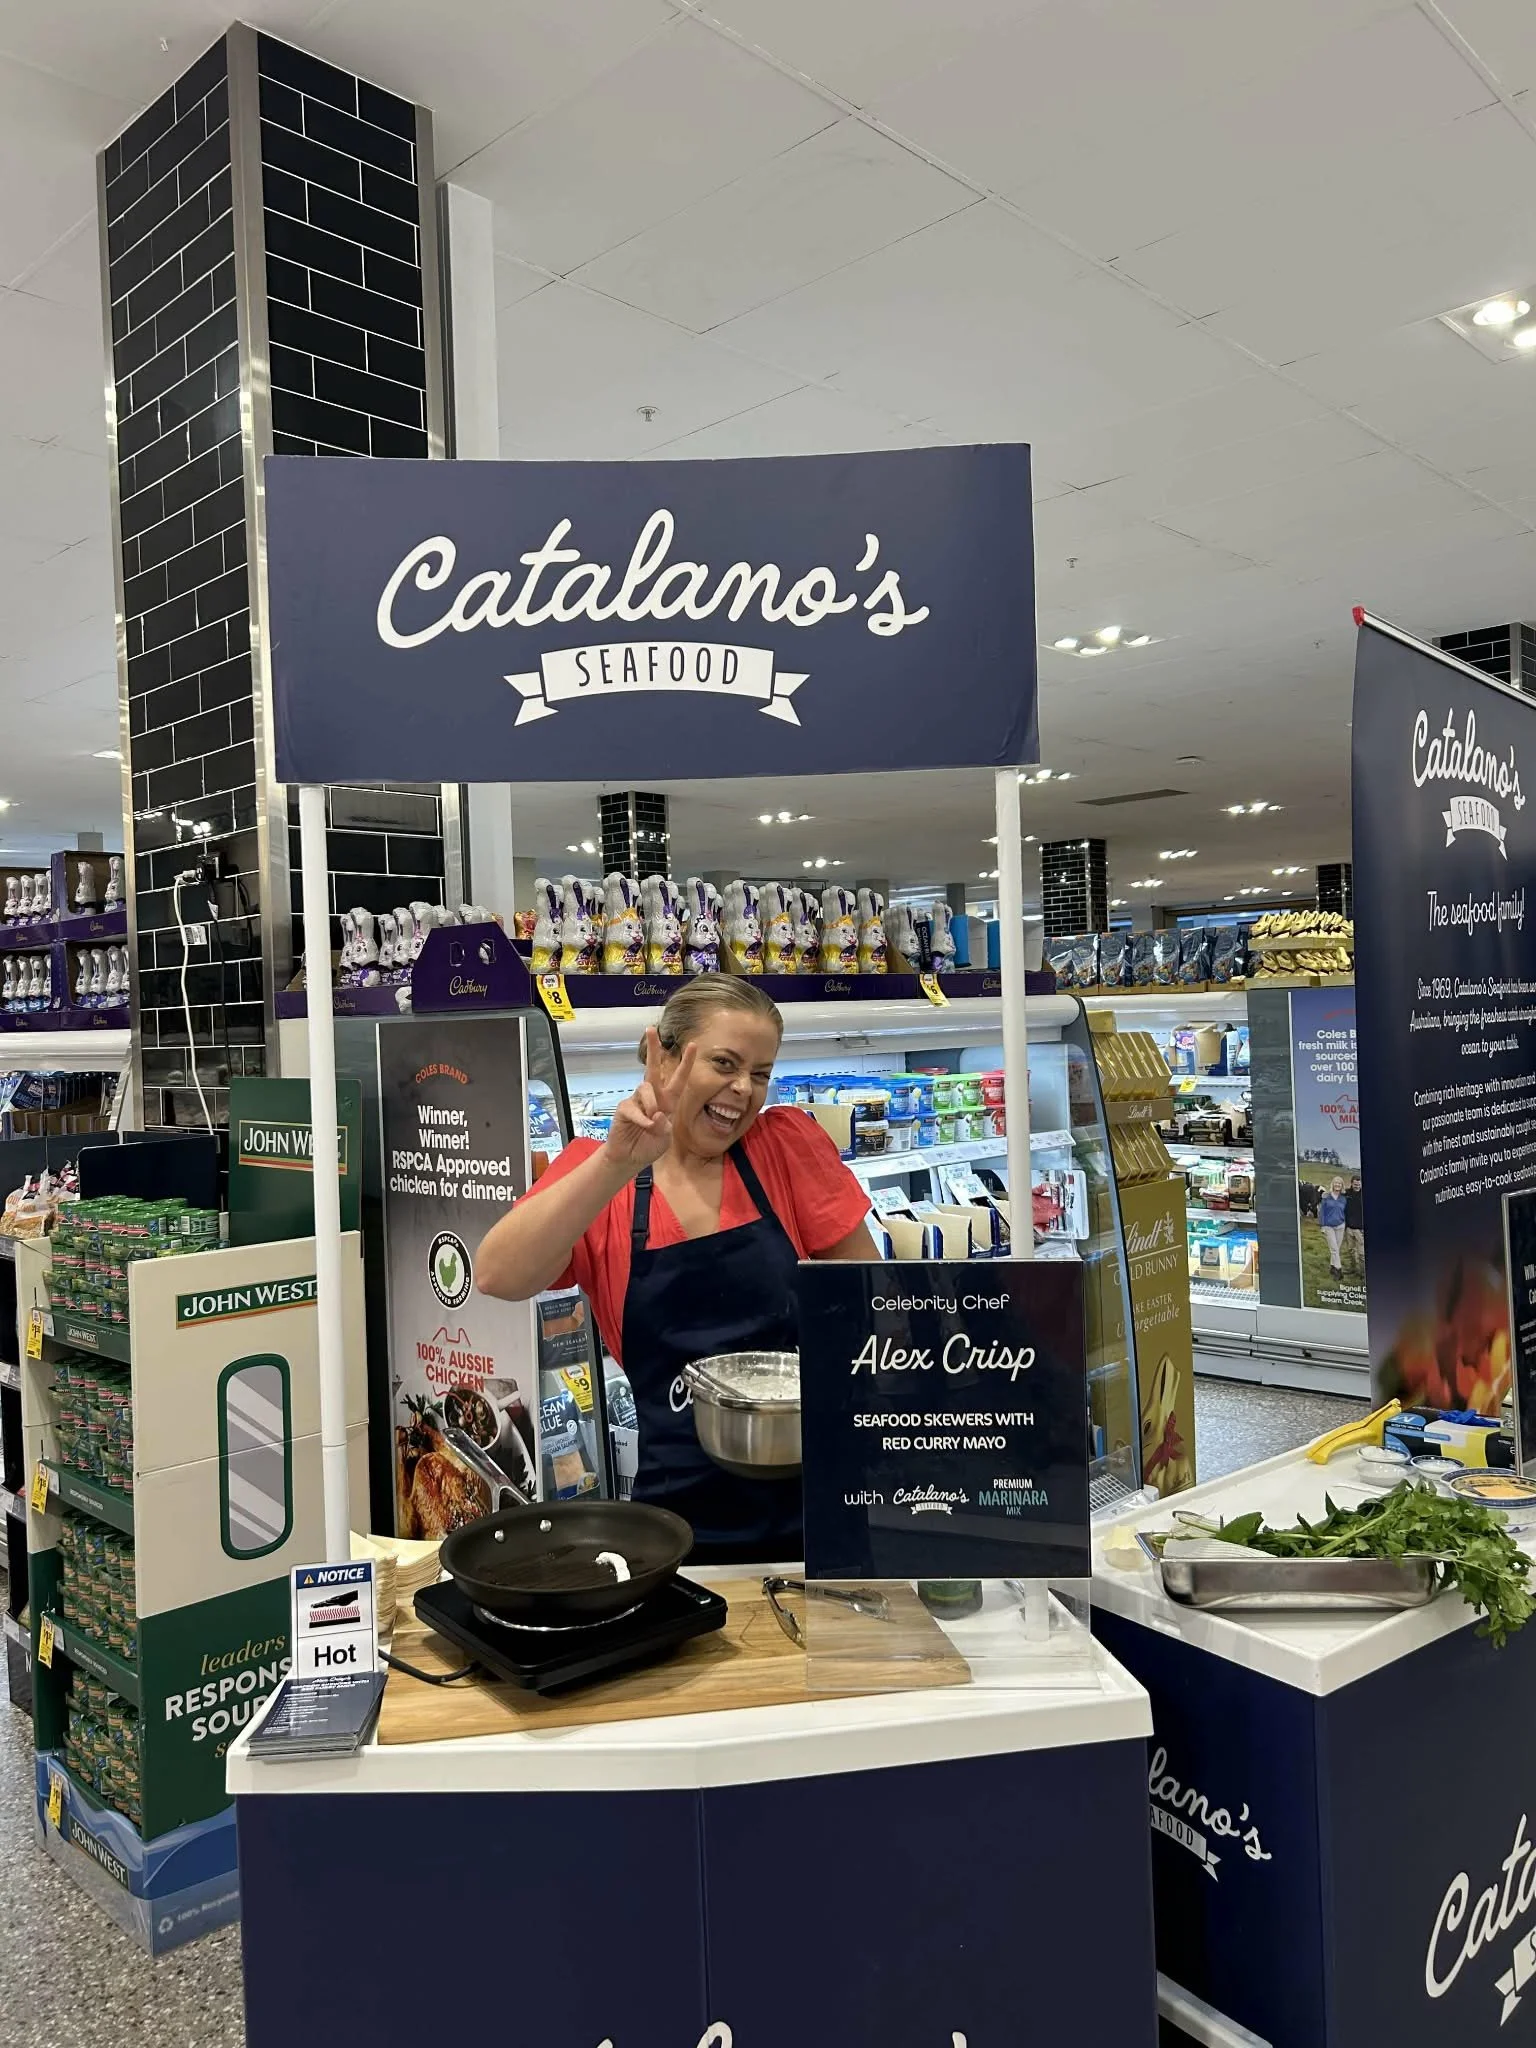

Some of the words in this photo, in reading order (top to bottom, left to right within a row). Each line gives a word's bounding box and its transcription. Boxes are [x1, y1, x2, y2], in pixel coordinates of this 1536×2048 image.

[377, 509, 929, 648] Catalano's
[575, 646, 740, 688] SEAFOOD
[1413, 708, 1525, 810] Catalano's
[1457, 801, 1495, 831] SEAFOOD
[1427, 891, 1449, 931] The
[1450, 893, 1497, 936] seafood
[1498, 887, 1525, 931] family!
[450, 976, 487, 997] Cadbury
[546, 991, 562, 1005] $8
[634, 980, 667, 998] Cadbury
[825, 980, 851, 994] Cadbury
[1418, 978, 1431, 999] Since
[1454, 977, 1487, 998] Catalano's
[1488, 976, 1511, 1000] Seafood
[1443, 1009, 1469, 1033] bringing
[1470, 1008, 1480, 1024] the
[1480, 1006, 1507, 1030] freshest
[1299, 1041, 1323, 1050] fresh
[1326, 1041, 1348, 1050] milk
[1317, 1030, 1347, 1039] Coles
[1315, 1051, 1357, 1061] sourced
[1461, 1042, 1480, 1055] ocean
[1481, 1038, 1488, 1053] to
[1488, 1039, 1506, 1059] your
[416, 1064, 438, 1084] COLES
[439, 1064, 468, 1085] BRAND
[1310, 1064, 1332, 1072] over
[1335, 1062, 1355, 1072] 100
[1316, 1073, 1344, 1084] dairy
[1413, 1086, 1443, 1107] Combining
[1443, 1085, 1455, 1101] rich
[1456, 1081, 1483, 1099] heritage
[1484, 1077, 1501, 1094] with
[417, 1105, 468, 1128] Winner,
[1127, 1104, 1147, 1119] Lindt
[1319, 1103, 1346, 1114] 100%
[1422, 1117, 1431, 1131] our
[1431, 1108, 1465, 1132] passionate
[1464, 1107, 1484, 1121] team
[1483, 1103, 1491, 1118] is
[1491, 1098, 1521, 1116] dedicated
[244, 1127, 290, 1154] JOHN
[292, 1130, 342, 1158] WE
[418, 1128, 470, 1150] Winner!
[1422, 1141, 1434, 1157] with
[1433, 1137, 1443, 1154] the
[1442, 1134, 1462, 1151] finest
[1461, 1129, 1476, 1146] and
[1476, 1121, 1515, 1142] sustainably
[392, 1150, 433, 1172] RSPCA
[436, 1153, 511, 1178] Approved
[1420, 1161, 1449, 1185] Catalano's
[1448, 1156, 1469, 1174] family
[1469, 1151, 1489, 1169] invite
[1489, 1151, 1504, 1168] you
[1503, 1147, 1512, 1161] to
[389, 1174, 437, 1196] chicken
[439, 1177, 459, 1198] for
[461, 1179, 517, 1201] dinner.
[1465, 1169, 1513, 1195] easy-to-cook
[1124, 1219, 1163, 1255] Lindt
[1145, 1253, 1179, 1276] BUNNY
[430, 1270, 453, 1306] APPROVED
[452, 1276, 471, 1306] FARMING
[1146, 1292, 1173, 1307] EASTER
[183, 1290, 250, 1317] JOHN
[872, 1295, 957, 1314] Celebrity
[962, 1294, 1010, 1310] Chef
[67, 1328, 82, 1339] JOHN
[82, 1330, 97, 1344] WEST
[416, 1342, 446, 1365] 100%
[448, 1350, 495, 1375] AUSSIE
[851, 1335, 935, 1375] Alex
[942, 1332, 1036, 1382] Crisp
[425, 1364, 485, 1393] CHICKEN
[573, 1377, 590, 1391] $9
[853, 1413, 922, 1428] SEAFOOD
[923, 1413, 993, 1427] SKEWERS
[994, 1412, 1035, 1426] WITH
[882, 1437, 911, 1450] RED
[913, 1437, 960, 1450] CURRY
[963, 1436, 1007, 1449] MAYO
[844, 1489, 885, 1505] with
[892, 1483, 970, 1505] Catalano's
[978, 1490, 1049, 1506] MARINARA
[993, 1478, 1034, 1489] PREMIUM
[1006, 1507, 1022, 1516] MIX
[317, 1567, 365, 1583] NOTICE
[201, 1635, 286, 1676] leaders
[314, 1644, 357, 1667] Hot
[71, 1821, 98, 1855] JOHN
[98, 1844, 127, 1883] WEST
[177, 1907, 201, 1921] 100%
